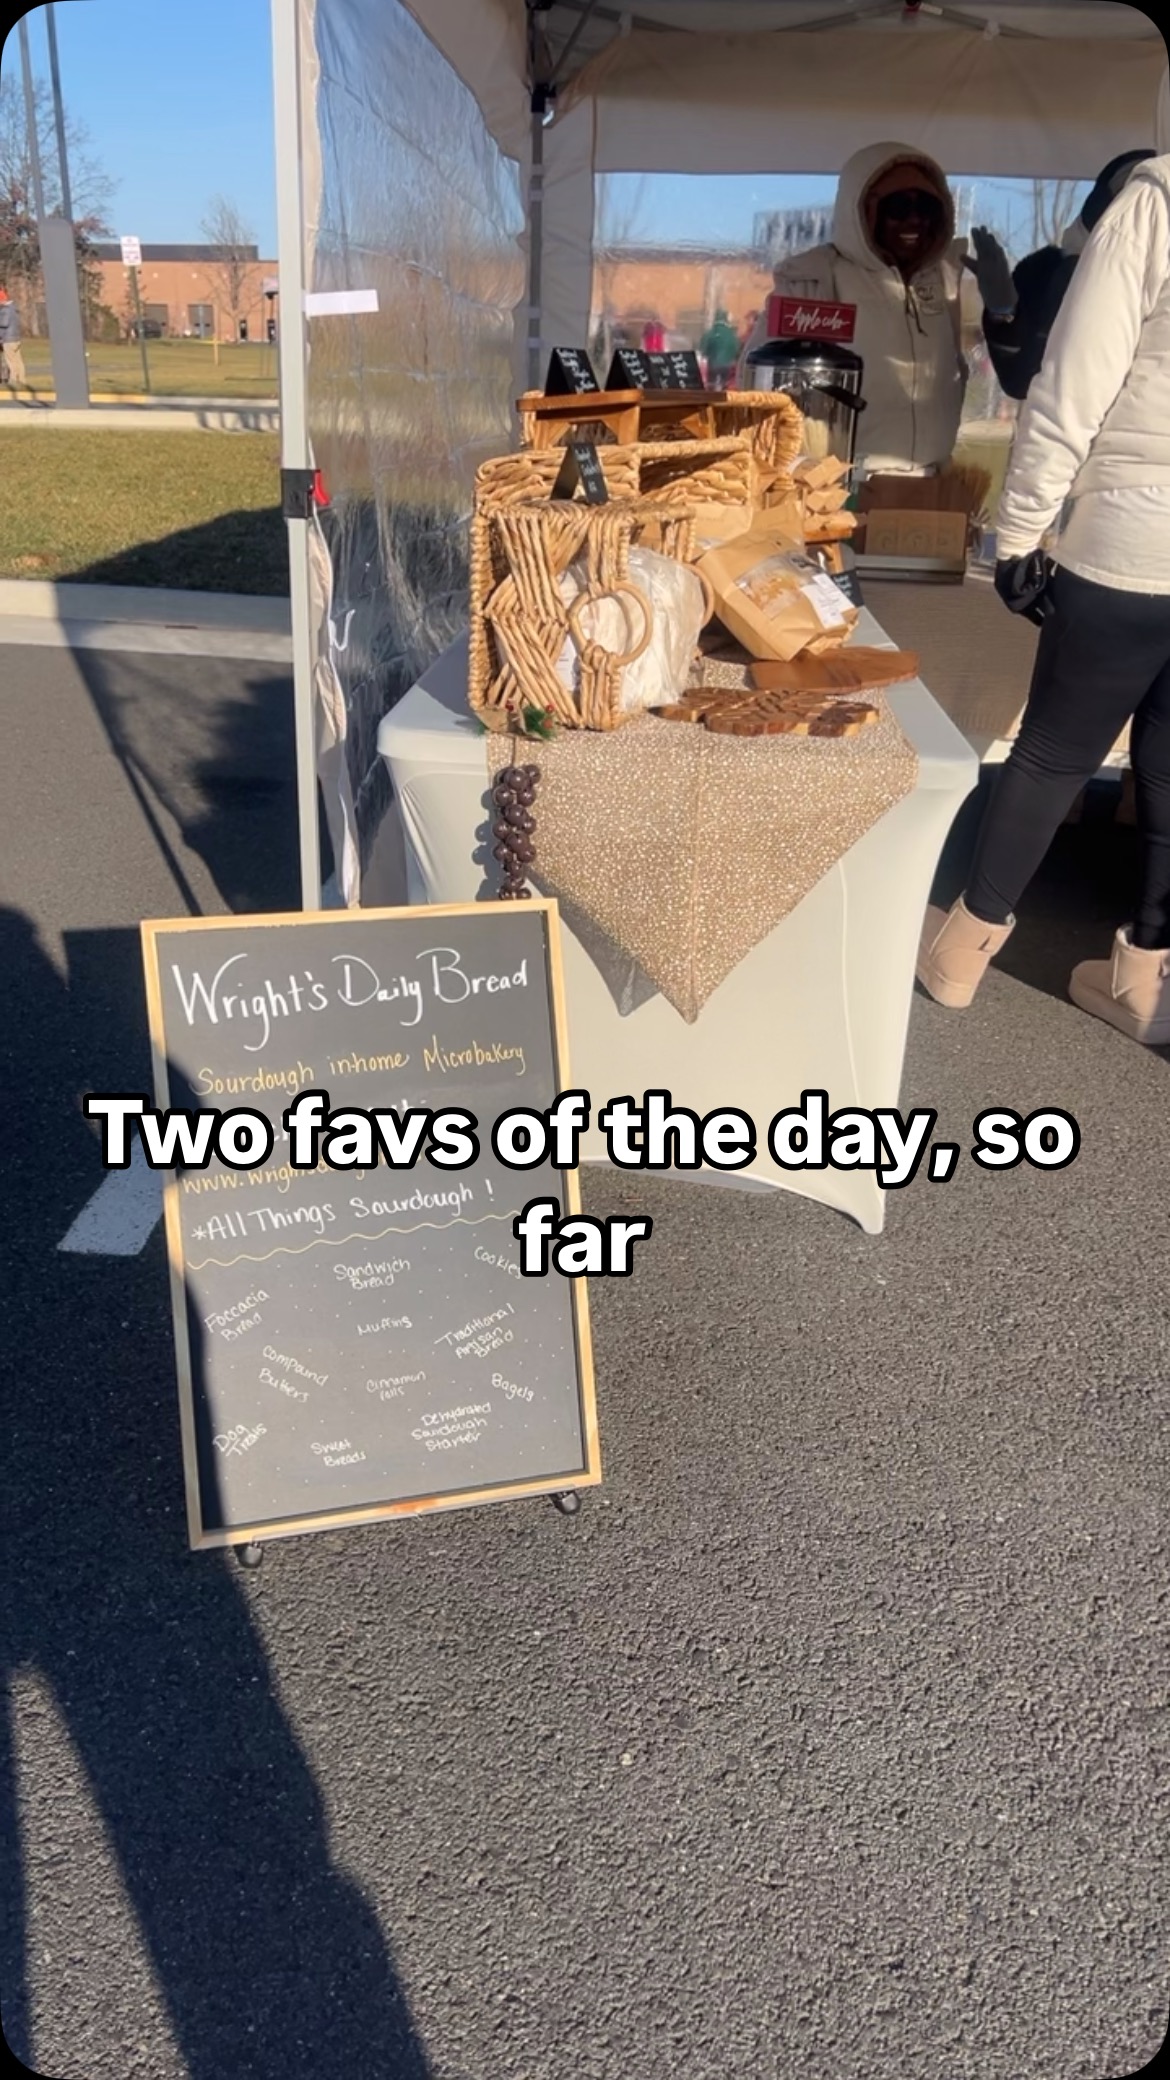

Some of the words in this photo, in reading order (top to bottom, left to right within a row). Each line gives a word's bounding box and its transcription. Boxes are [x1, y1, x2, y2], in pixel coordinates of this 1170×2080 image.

[171, 953, 328, 1051] Wright's
[332, 953, 423, 1026] Daily
[416, 947, 528, 1003] Bread
[191, 1062, 315, 1096] Sourdough
[247, 1203, 337, 1234] Things
[349, 1183, 474, 1218] Sourdough
[333, 1257, 411, 1280] Sandwich
[351, 1274, 394, 1290] Bread
[204, 1289, 270, 1333] Foccacia
[434, 1303, 514, 1346] Traditional
[221, 1312, 262, 1341] Bread
[357, 1315, 412, 1336] Muffins
[455, 1327, 503, 1359] Artisan
[262, 1345, 329, 1386] Compound
[258, 1368, 309, 1402] Butters
[366, 1370, 426, 1393] Cinnamon
[492, 1372, 534, 1402] Bagels
[421, 1402, 491, 1426] Dehydrated
[213, 1424, 251, 1452] Dog
[411, 1417, 488, 1440] Sourdough
[425, 1431, 481, 1452] Starter
[310, 1438, 351, 1455] Sweet
[323, 1451, 367, 1467] Breads
